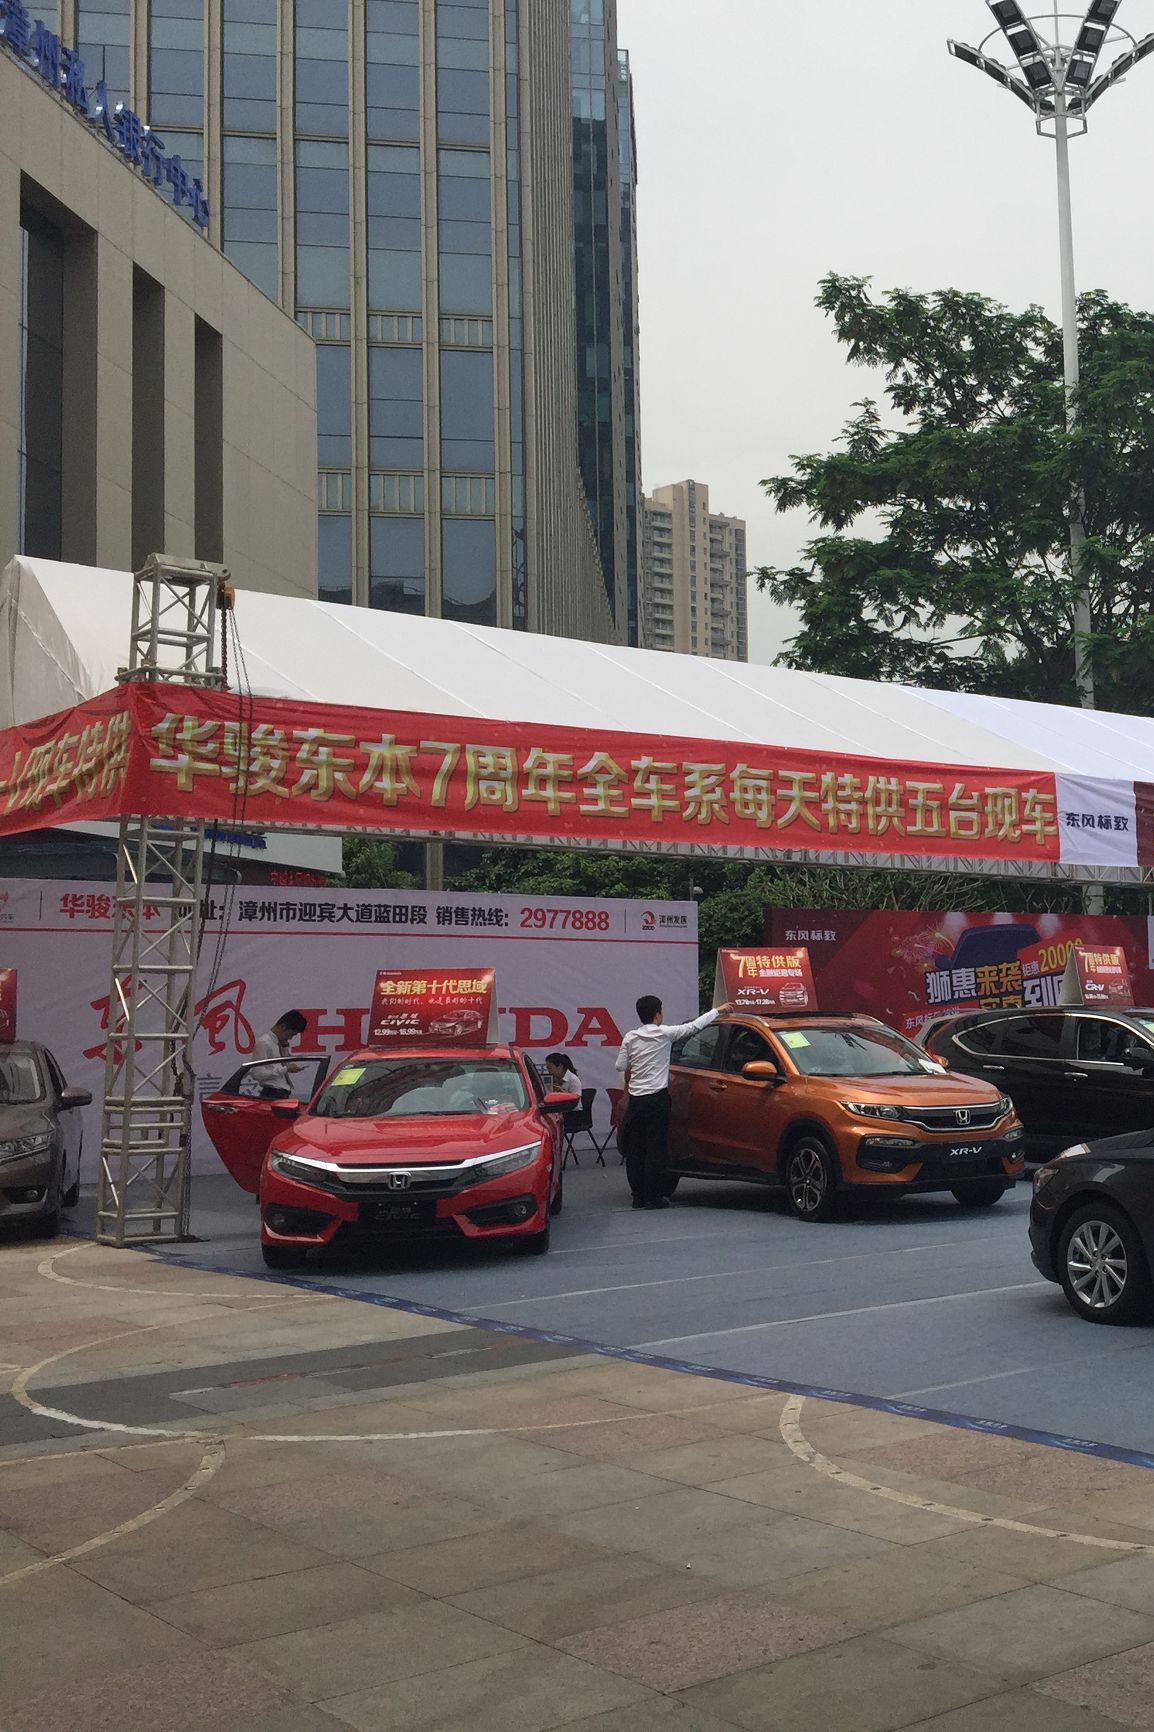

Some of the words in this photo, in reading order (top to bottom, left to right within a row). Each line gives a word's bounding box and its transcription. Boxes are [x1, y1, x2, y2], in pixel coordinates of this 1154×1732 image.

[150, 711, 1057, 845] 华骏东本7周年全车系每天特供五台现车
[1065, 812, 1129, 832] 东风标致
[238, 901, 428, 925] 漳州市迎宾大道蓝田段
[519, 907, 610, 931] 2977888
[785, 929, 837, 942] 东风标致
[1038, 938, 1083, 973] 2000
[379, 979, 489, 996] 全新第十代思域
[737, 988, 770, 996] XR-V
[925, 960, 1023, 1004] 狮惠来袭
[290, 1006, 626, 1053] HDA
[380, 1018, 421, 1026] CIVIC
[949, 1147, 982, 1156] XR-V
